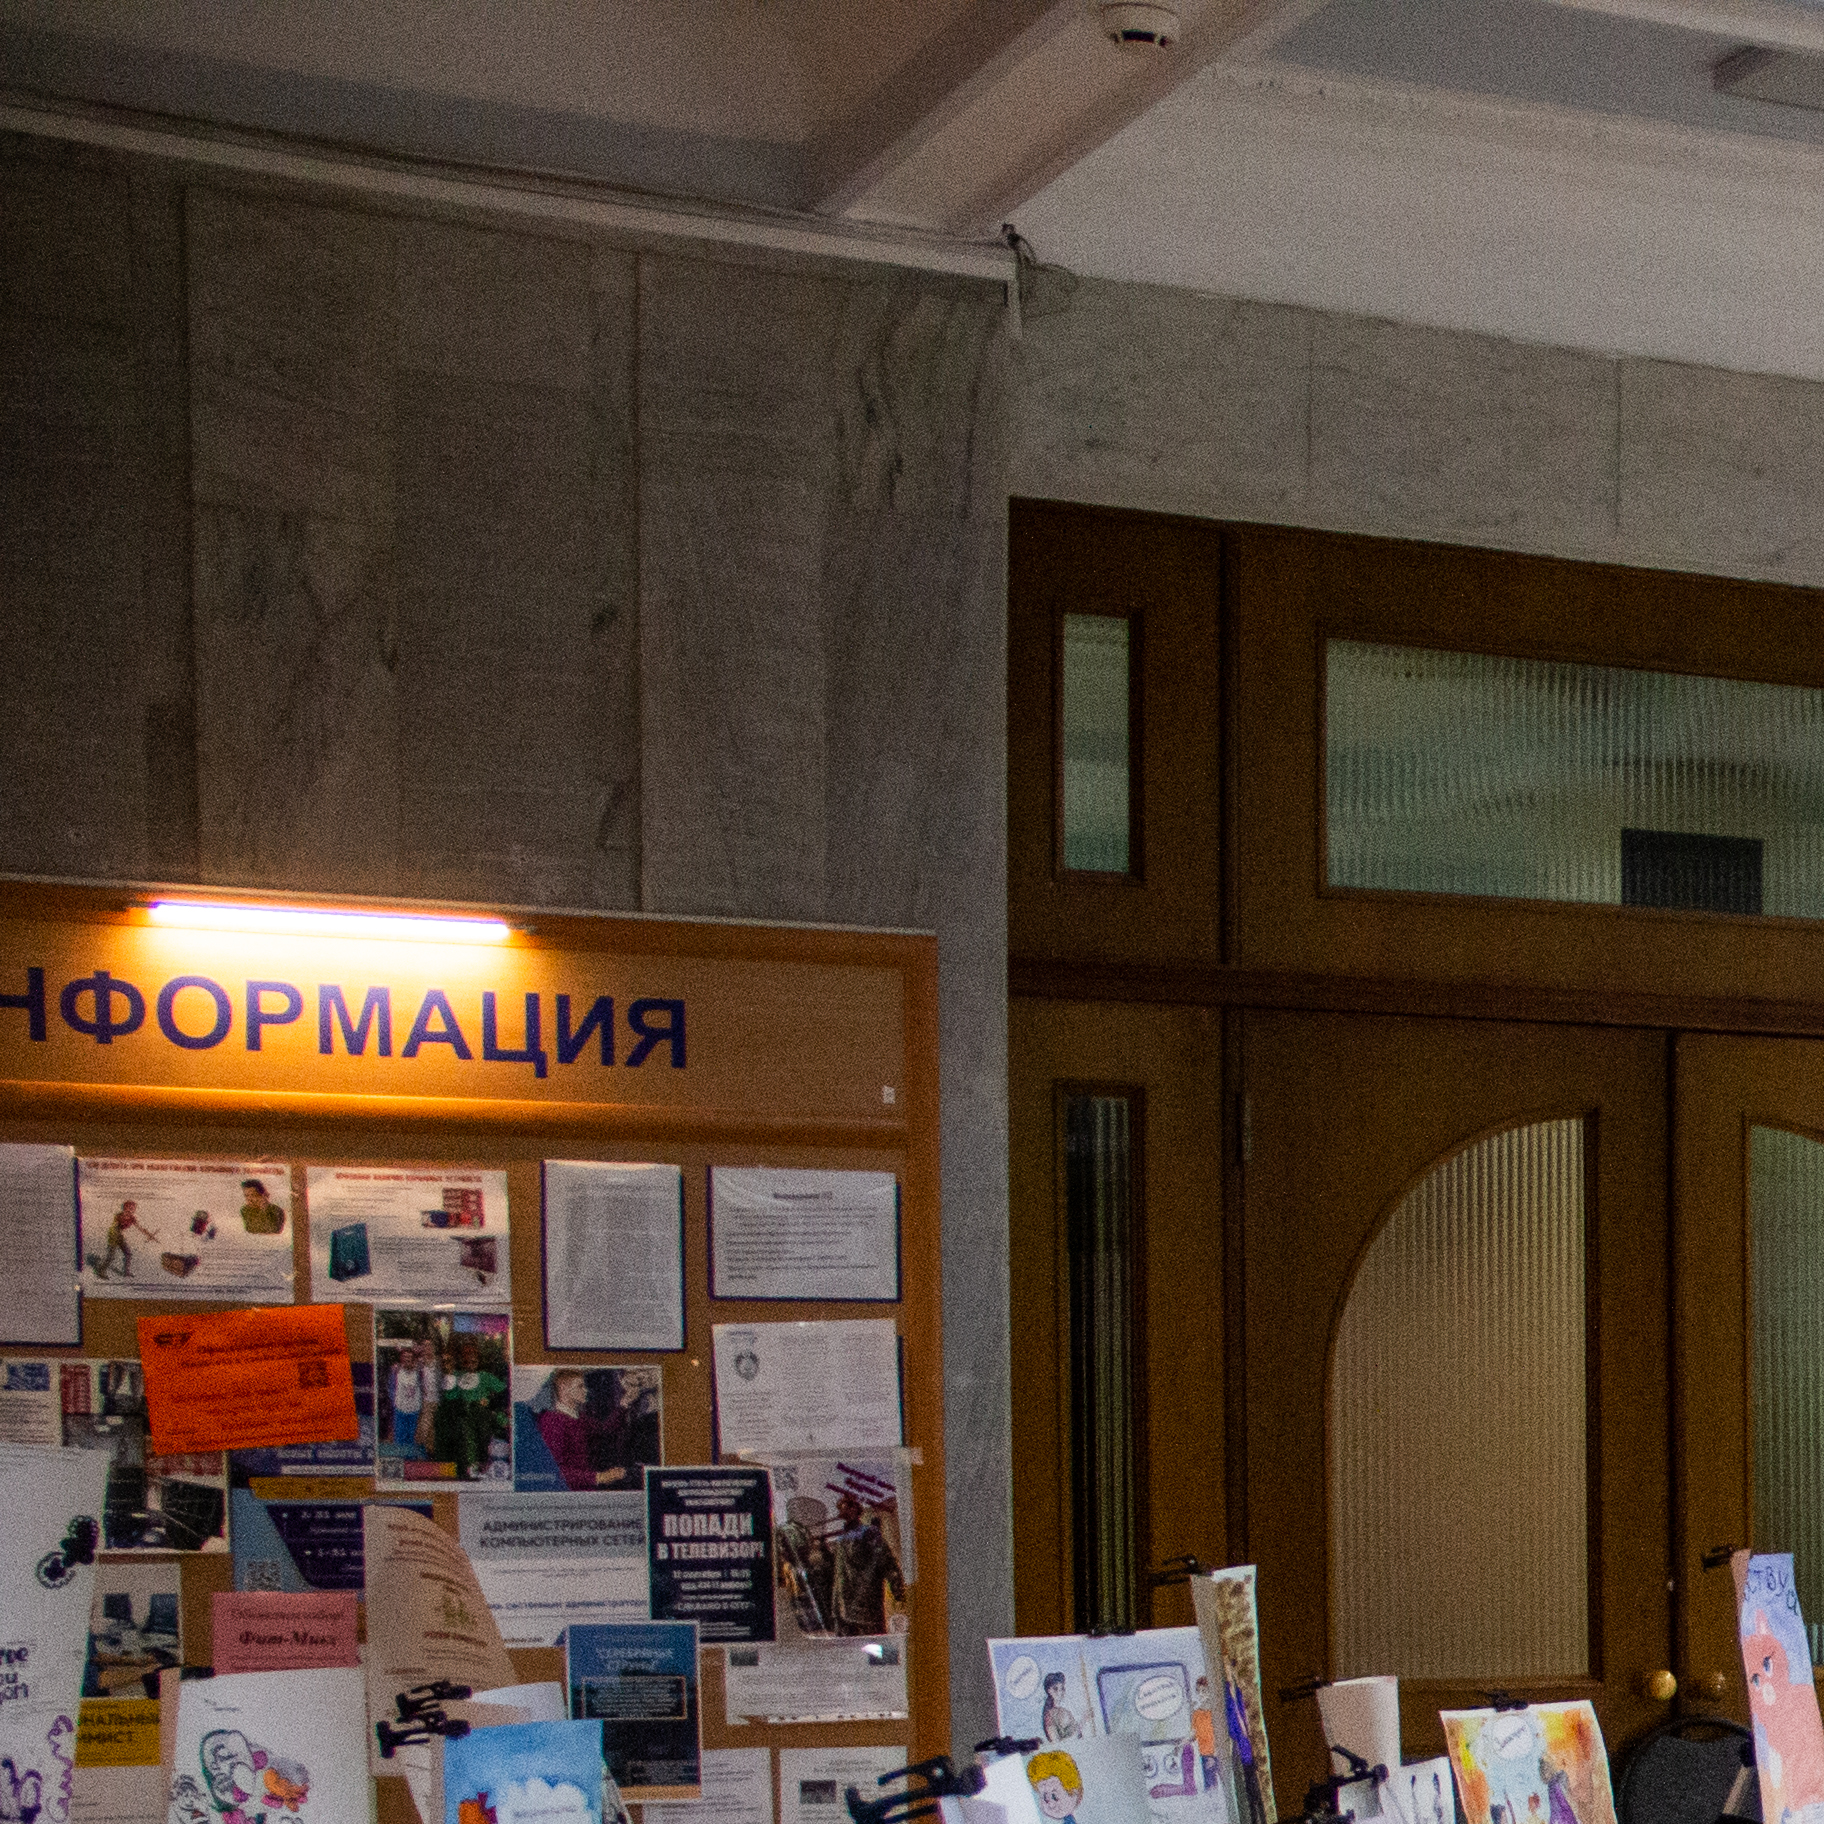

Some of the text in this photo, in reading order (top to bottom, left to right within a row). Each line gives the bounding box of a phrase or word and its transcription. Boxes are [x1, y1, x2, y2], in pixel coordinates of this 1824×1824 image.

[0, 966, 688, 1078] НФОРМАЦИЯ
[482, 1519, 643, 1533] АДМИНИСТРИРОВАНИЕ
[663, 1512, 754, 1539] ПОПАДИ
[480, 1535, 598, 1549] КОМПЬЮТЕРНЫХ
[656, 1540, 765, 1560] В ТЕЛЕВИЗОР!
